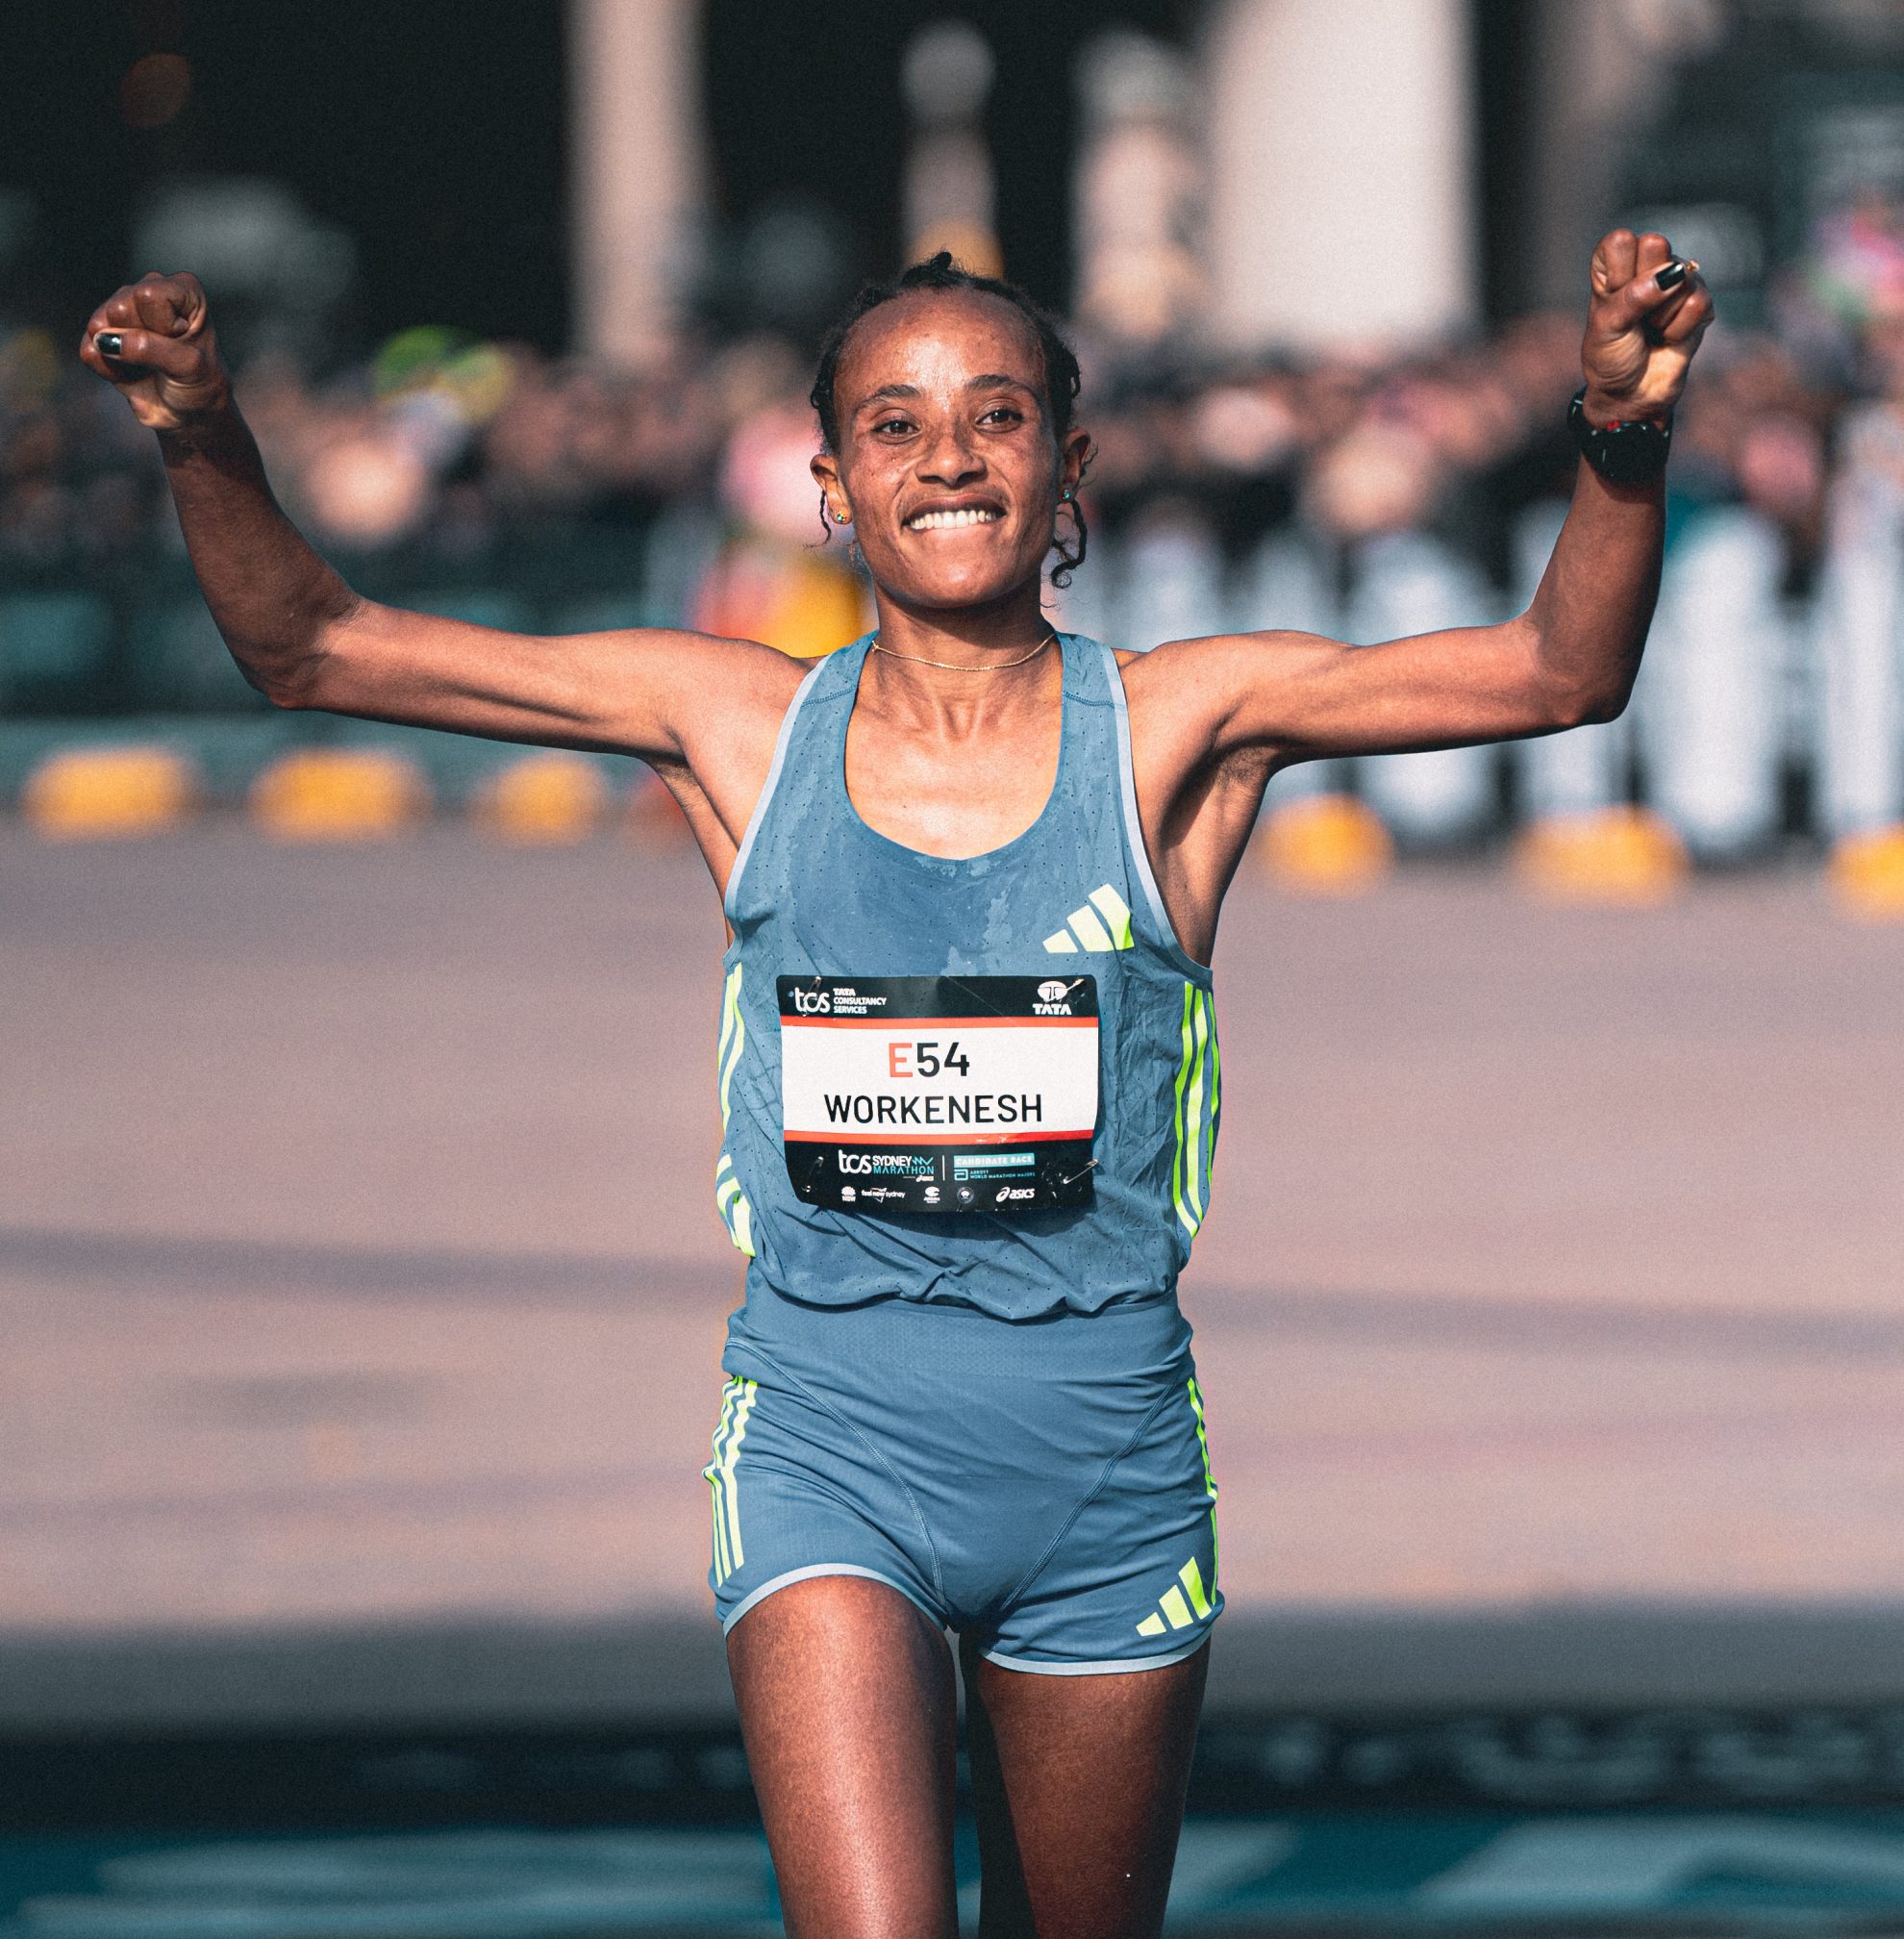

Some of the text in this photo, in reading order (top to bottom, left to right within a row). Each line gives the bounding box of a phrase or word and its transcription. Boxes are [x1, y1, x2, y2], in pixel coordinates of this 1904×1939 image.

[833, 988, 856, 996] TATA
[833, 996, 887, 1006] CONSULTANCY
[1032, 1003, 1072, 1015] TATA
[889, 1042, 970, 1078] E54
[823, 1094, 1042, 1124] WORKENESH
[872, 1155, 912, 1167] SYDNEY
[957, 1155, 1033, 1166] CANDIDATE RACE
[872, 1166, 935, 1174] MARATHON
